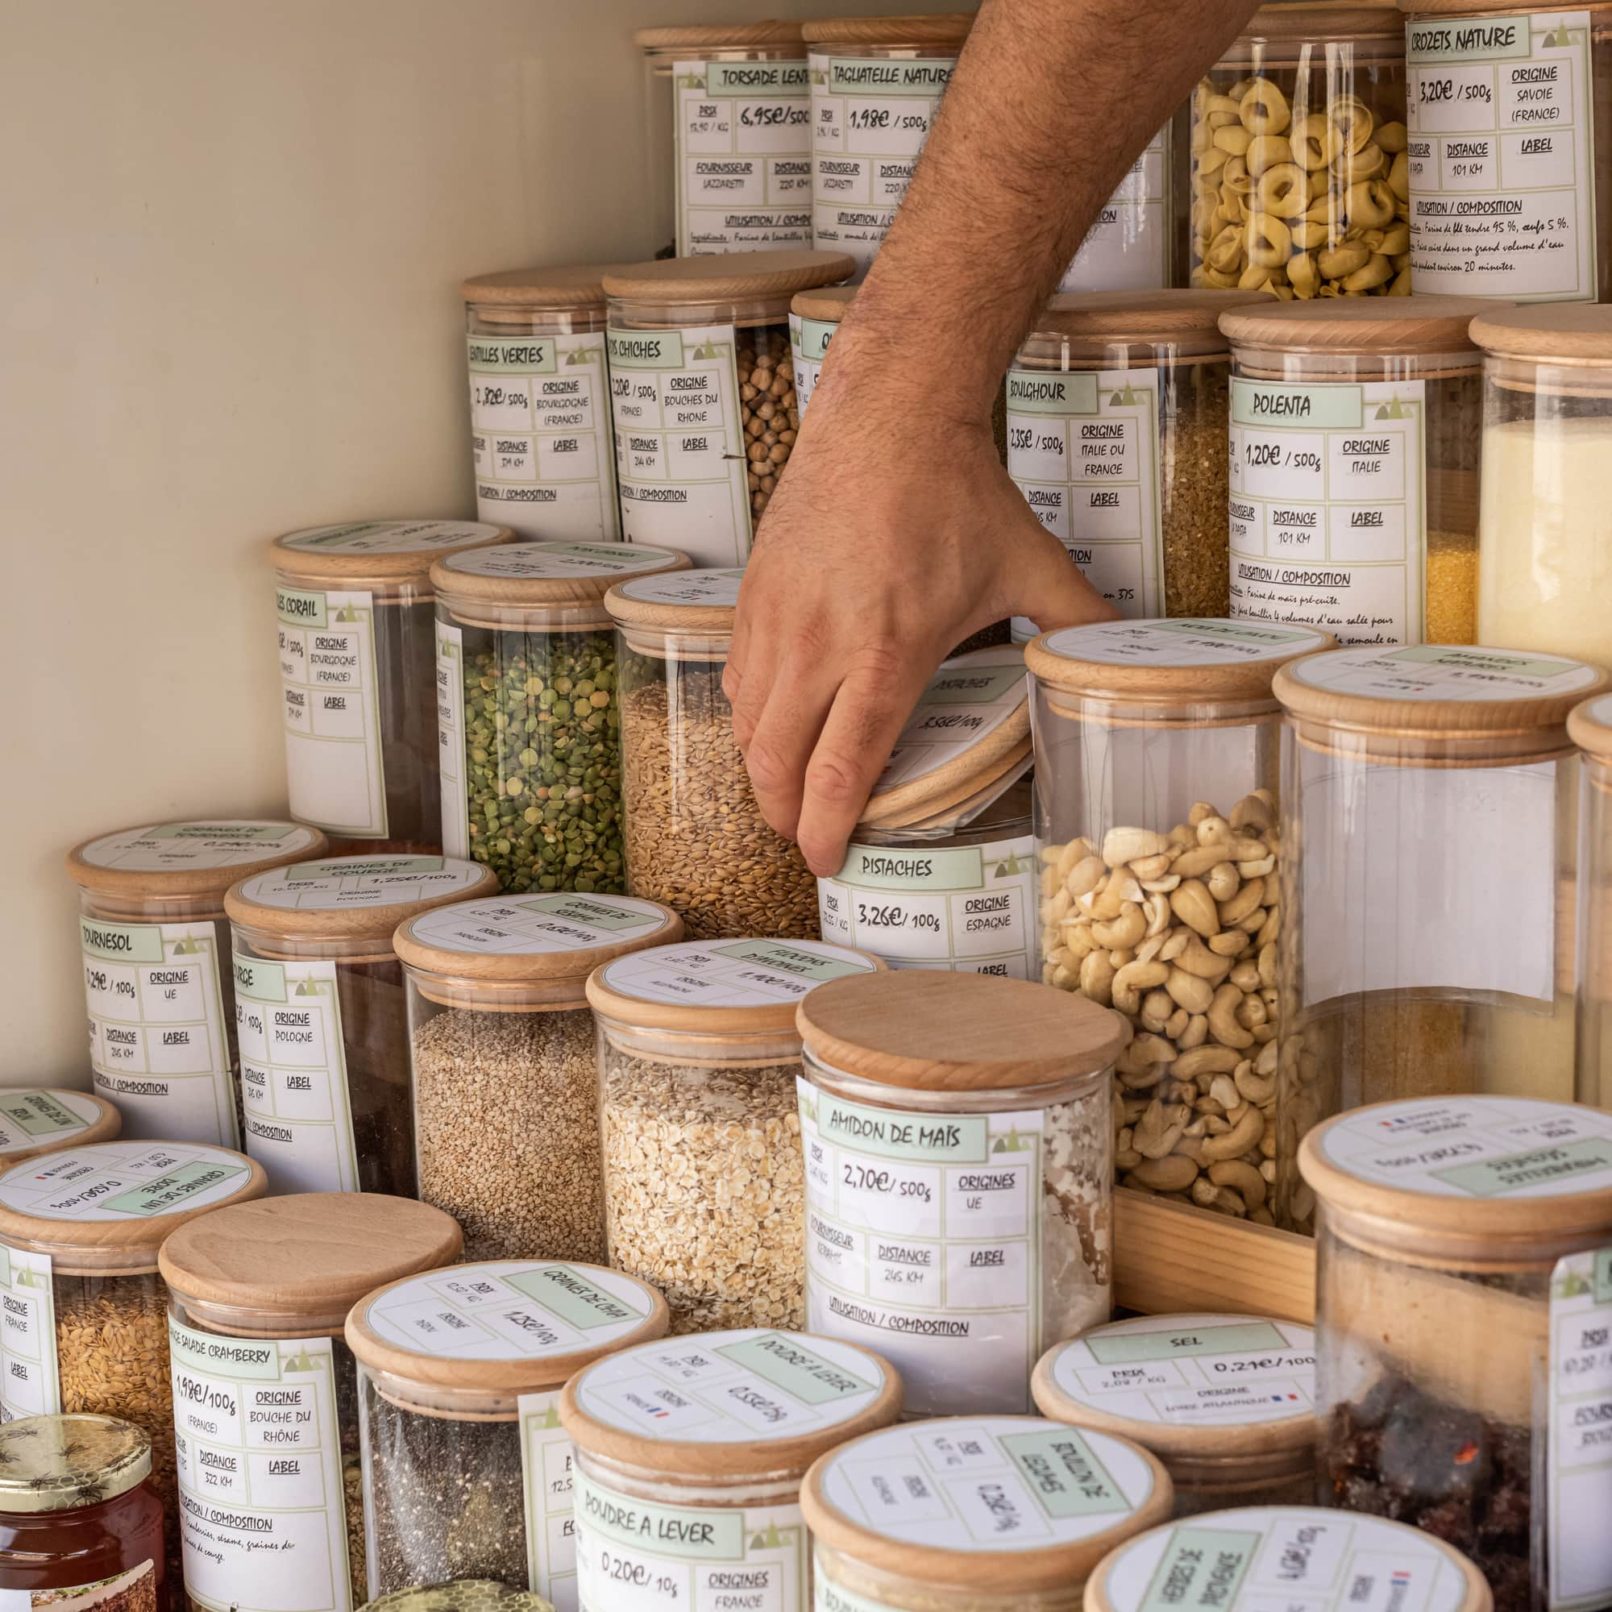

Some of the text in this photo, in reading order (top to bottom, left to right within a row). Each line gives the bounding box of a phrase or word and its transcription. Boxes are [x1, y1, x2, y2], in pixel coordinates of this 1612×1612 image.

[1456, 27, 1515, 48] NATURE
[722, 69, 778, 84] TORSADE
[835, 66, 953, 83] TAGLIATELLE NATURE
[1512, 67, 1557, 81] ORIGINE
[1420, 81, 1491, 103] 3,20€ 500g
[1517, 89, 1552, 101] SAVOIE
[851, 110, 927, 132] 1,98€ 500g
[1511, 108, 1559, 122] (FRANCE)
[1447, 143, 1488, 155] DISTANCE
[1521, 139, 1552, 151] LABEL
[697, 163, 752, 172] FOURNISSEUR
[1452, 165, 1482, 176] 101 KM
[1457, 201, 1522, 213] COMPOSITION
[1493, 221, 1504, 232] 95
[1548, 219, 1554, 230] 5
[1475, 243, 1500, 257] grand
[1503, 240, 1535, 252] volume
[1464, 261, 1476, 273] 20
[502, 348, 543, 363] VERTES
[619, 342, 661, 357] CHICHES
[543, 381, 579, 392] ORIGINE
[670, 377, 707, 388] ORIGINE
[638, 385, 656, 400] 500g
[537, 397, 588, 409] BOURGOGNE
[665, 394, 718, 406] BOUCHES DU
[1254, 394, 1310, 416] POLENTA
[544, 415, 583, 425] (FRANCE)
[1081, 425, 1124, 437] ORIGINE
[554, 440, 578, 449] LABEL
[683, 438, 708, 449] LABEL
[1042, 437, 1064, 455] 500g
[1343, 440, 1390, 453] ORIGINE
[1082, 445, 1125, 456] ITALIE OU
[1246, 445, 1321, 472] 1,20€ 500g
[1085, 464, 1122, 474] FRANCE
[1352, 461, 1380, 472] ITALIE
[507, 490, 556, 499] COMPOSITION
[640, 489, 687, 500] COMPOSITION
[1091, 493, 1119, 505] LABEL
[1273, 511, 1317, 525] DISTANCE
[1351, 512, 1383, 524] LABEL
[1278, 532, 1310, 543] 101 KM
[1282, 571, 1350, 584] COMPOSITION
[286, 598, 317, 617] CORAIL
[1282, 613, 1314, 624] volumes
[1318, 613, 1342, 624] d'eau
[1347, 615, 1368, 625] salée
[316, 638, 348, 649] ORIGINE
[1347, 633, 1384, 645] semoule
[311, 655, 356, 666] BOURGOGNE
[324, 696, 346, 707] LABEL
[862, 856, 932, 877] PISTACHES
[965, 896, 1010, 911] ORIGINE
[913, 914, 940, 931] 100g
[966, 915, 1011, 930] ESPAGNE
[150, 971, 188, 982] ORIGINE
[116, 982, 135, 998] 100g
[165, 990, 176, 999] UE
[275, 1013, 310, 1024] ORIGINE
[163, 1033, 190, 1043] LABEL
[276, 1032, 312, 1042] POLOGNE
[118, 1081, 168, 1093] COMPOSITION
[287, 1077, 311, 1088] LABEL
[830, 1110, 960, 1147] AMIDON DE MAÏS
[958, 1174, 1015, 1189] ORIGINES
[901, 1182, 931, 1202] 500g
[967, 1197, 982, 1209] UE
[878, 1244, 931, 1263] DISTANCE
[970, 1251, 1004, 1265] LABEL
[907, 1272, 923, 1283] KM
[829, 1296, 969, 1334] UTILISATION COMPOSITION
[5, 1317, 28, 1332] FRANCE
[1170, 1337, 1203, 1347] SEL
[181, 1335, 206, 1355] SALADE
[209, 1345, 270, 1363] CRAMBERRY
[11, 1361, 28, 1378] LABEL
[1111, 1368, 1146, 1378] PRIX
[256, 1392, 301, 1403] ORIGINE
[251, 1411, 311, 1423] BOUCHE DU
[188, 1415, 217, 1434] (FRANCE)
[264, 1429, 300, 1441] RHÔNE
[200, 1450, 236, 1469] DISTANCE
[269, 1460, 300, 1473] LABEL
[220, 1475, 232, 1487] KM
[211, 1510, 272, 1530] COMPOSITION
[586, 1490, 714, 1544] POUDRE A LEVER
[709, 1571, 769, 1587] ORIGINES
[658, 1577, 678, 1598] 10g
[714, 1596, 763, 1609] FRANCE
